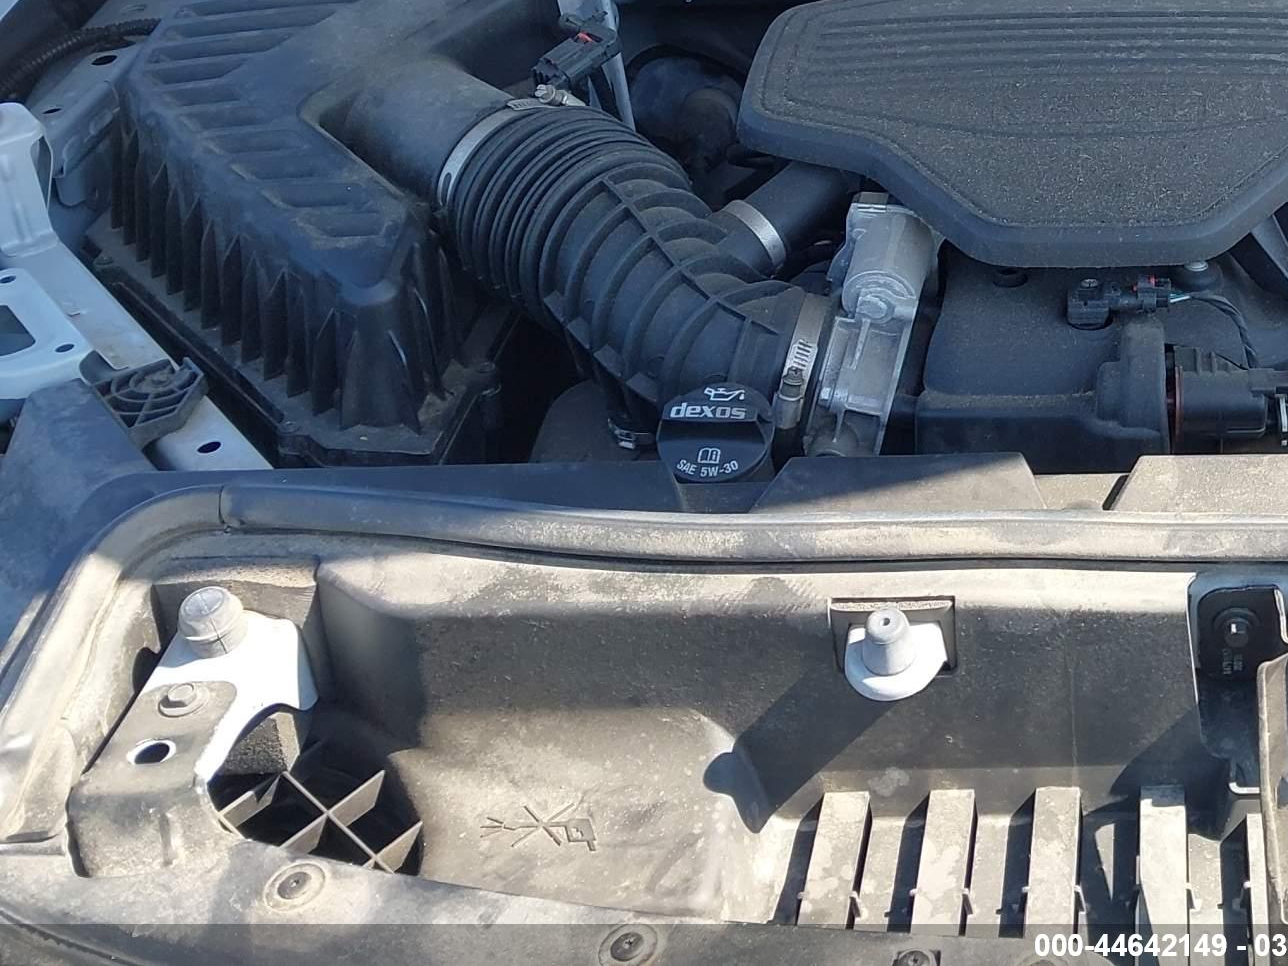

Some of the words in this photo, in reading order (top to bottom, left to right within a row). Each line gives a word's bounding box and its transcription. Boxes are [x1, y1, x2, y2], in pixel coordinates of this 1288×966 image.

[670, 402, 747, 420] dexos
[676, 459, 697, 475] SAE
[700, 460, 739, 477] 5W-30
